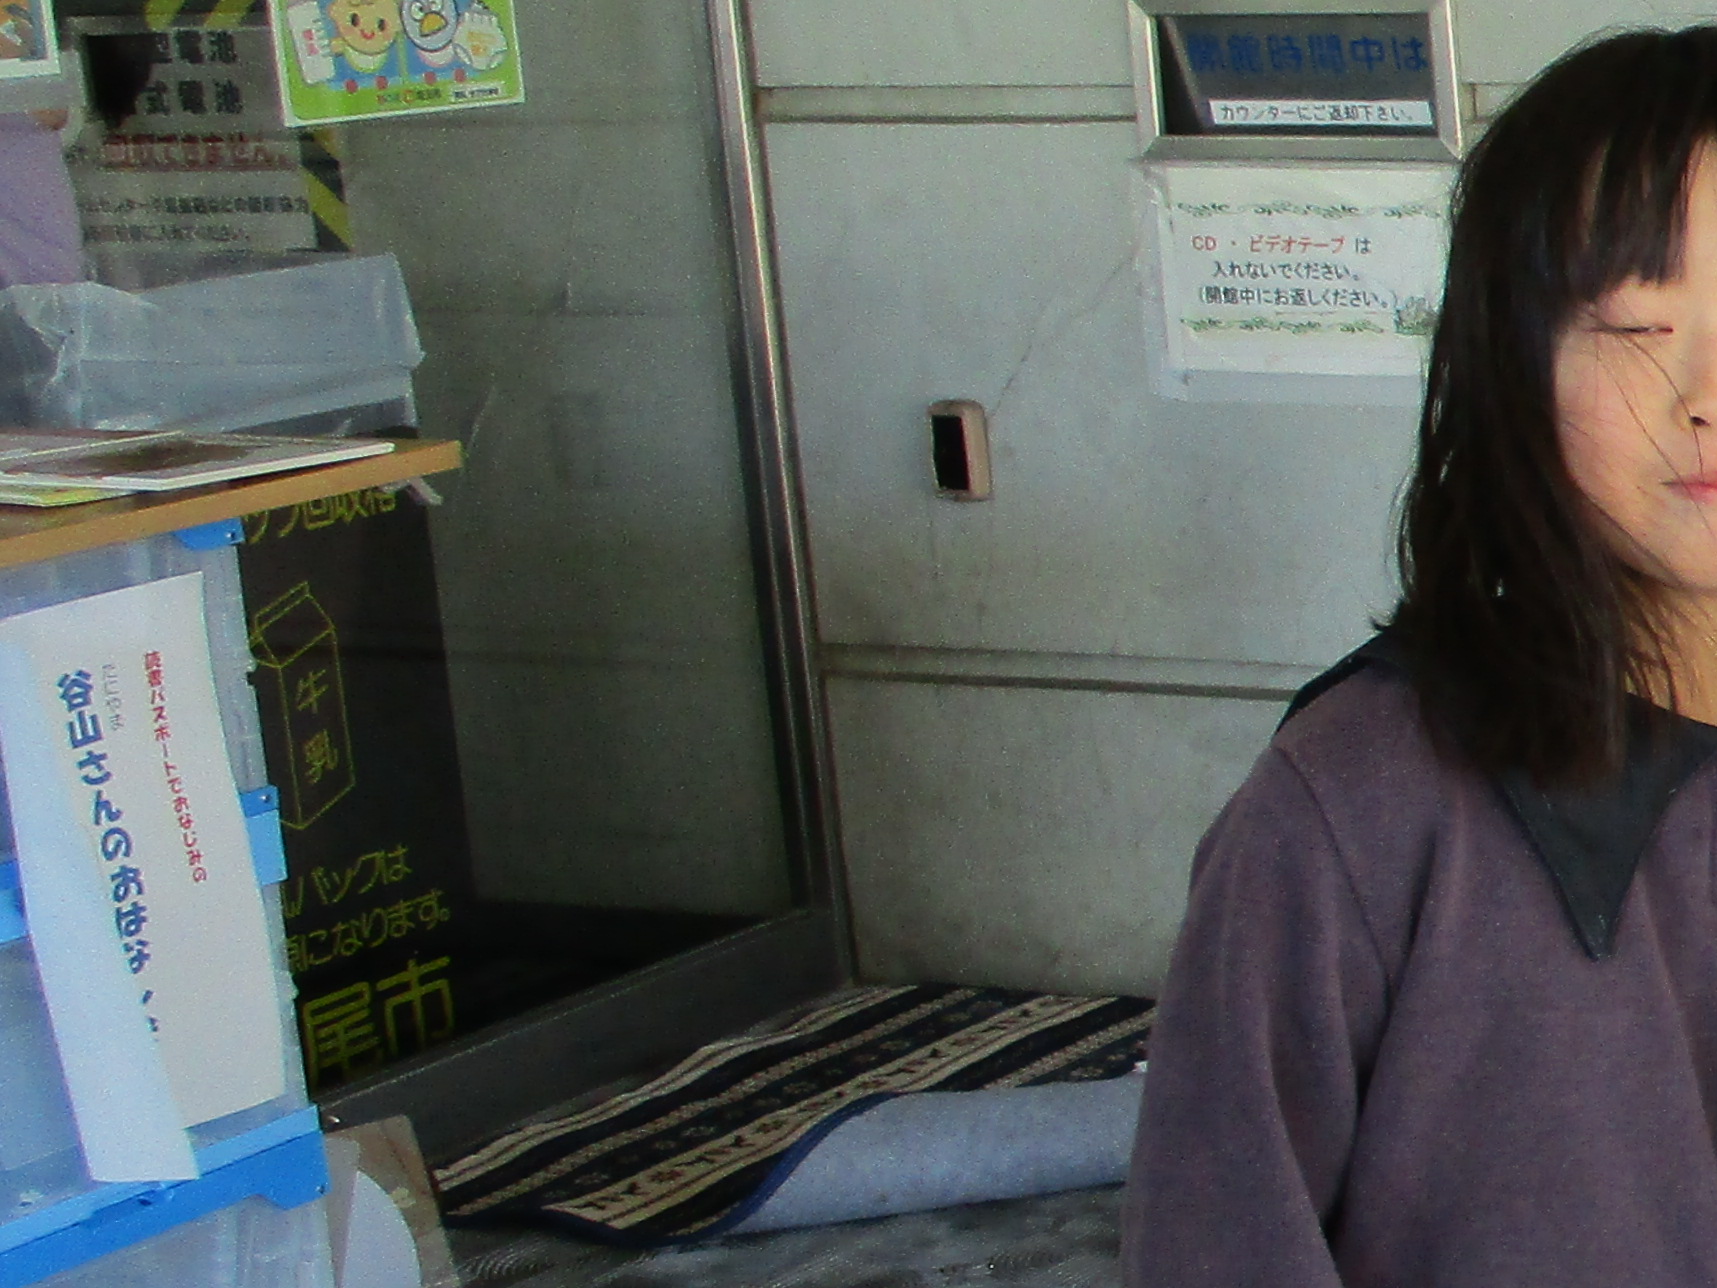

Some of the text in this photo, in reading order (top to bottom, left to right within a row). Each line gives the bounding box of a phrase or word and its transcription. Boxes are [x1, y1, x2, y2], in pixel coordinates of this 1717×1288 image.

[1192, 236, 1218, 252] CD
[1355, 236, 1373, 255] は
[295, 666, 340, 786] 牛乳
